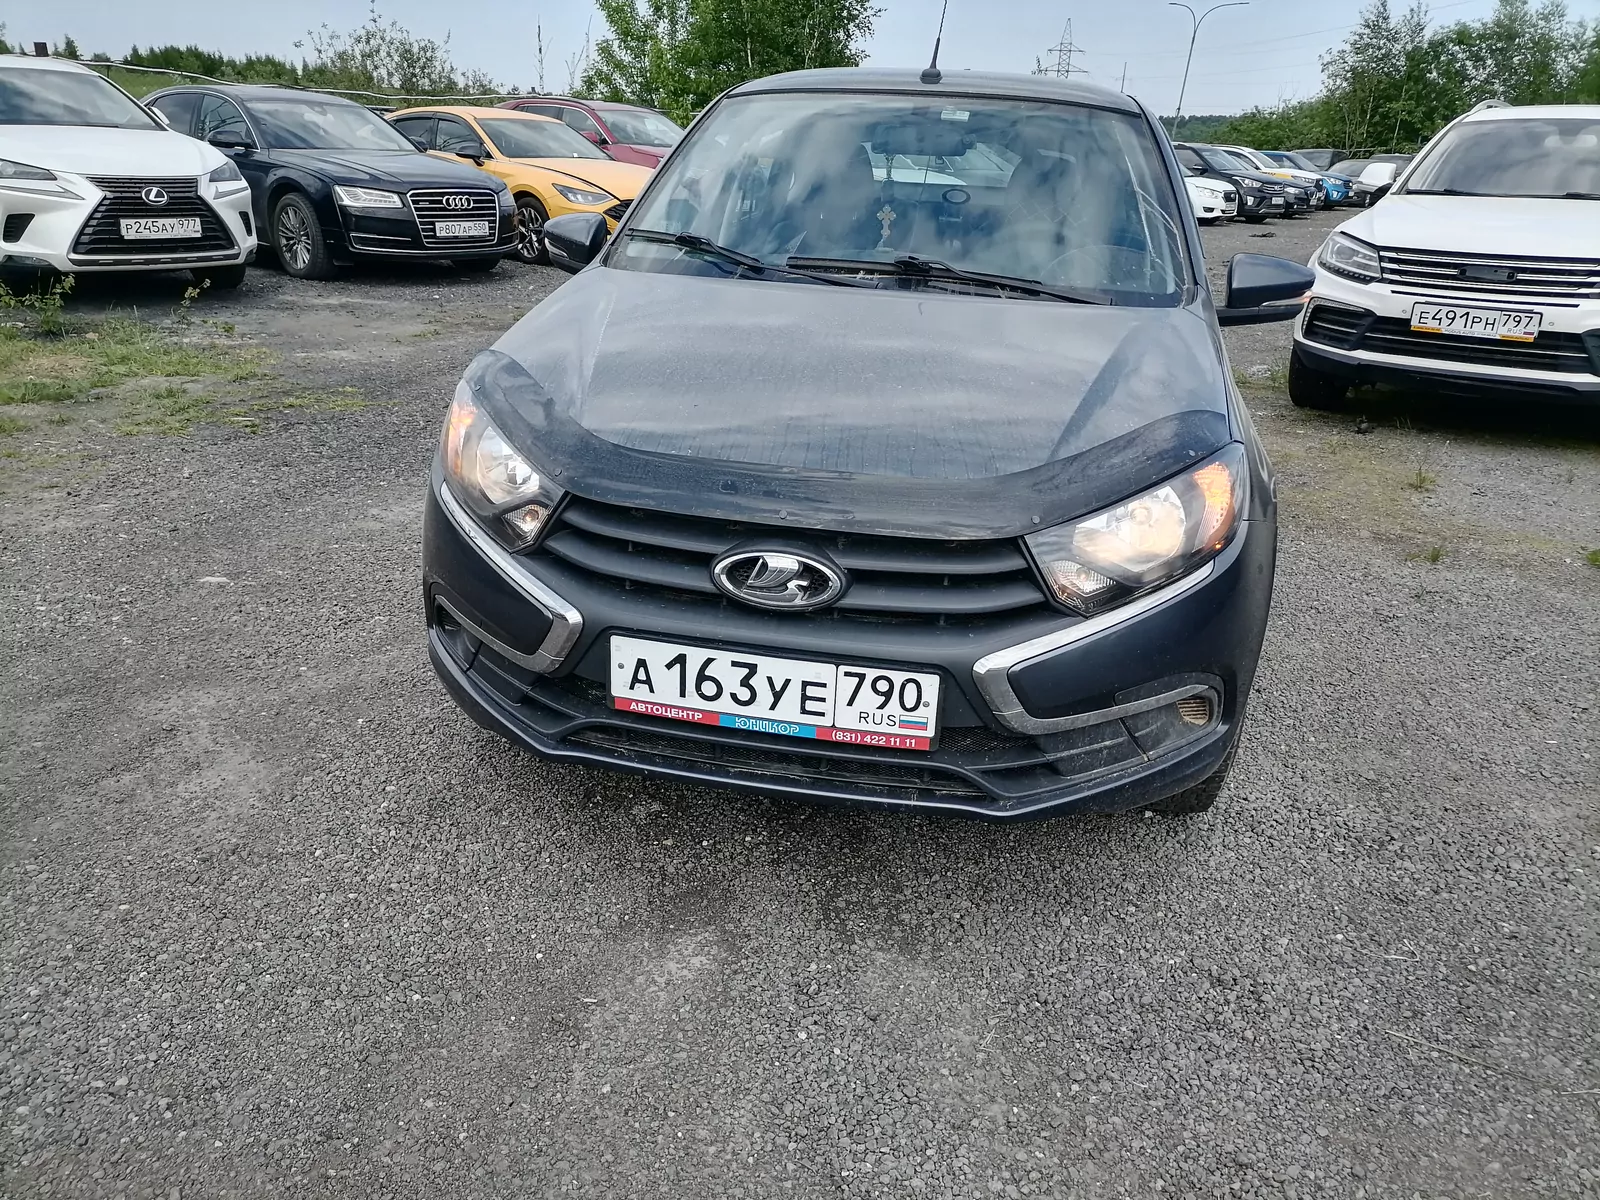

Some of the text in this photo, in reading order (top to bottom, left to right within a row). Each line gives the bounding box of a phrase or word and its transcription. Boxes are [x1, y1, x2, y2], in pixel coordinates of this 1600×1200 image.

[177, 218, 196, 229] 977
[474, 222, 487, 231] 550
[1418, 308, 1534, 331] Е491РН 797
[1507, 327, 1523, 335] RUS
[628, 652, 923, 717] А163УЕ 790
[629, 701, 703, 721] АВТОЦЕНТР
[735, 717, 800, 735] ЮНИКОР
[831, 729, 861, 743] (831)
[863, 734, 886, 745] 422
[858, 711, 897, 727] RUS
